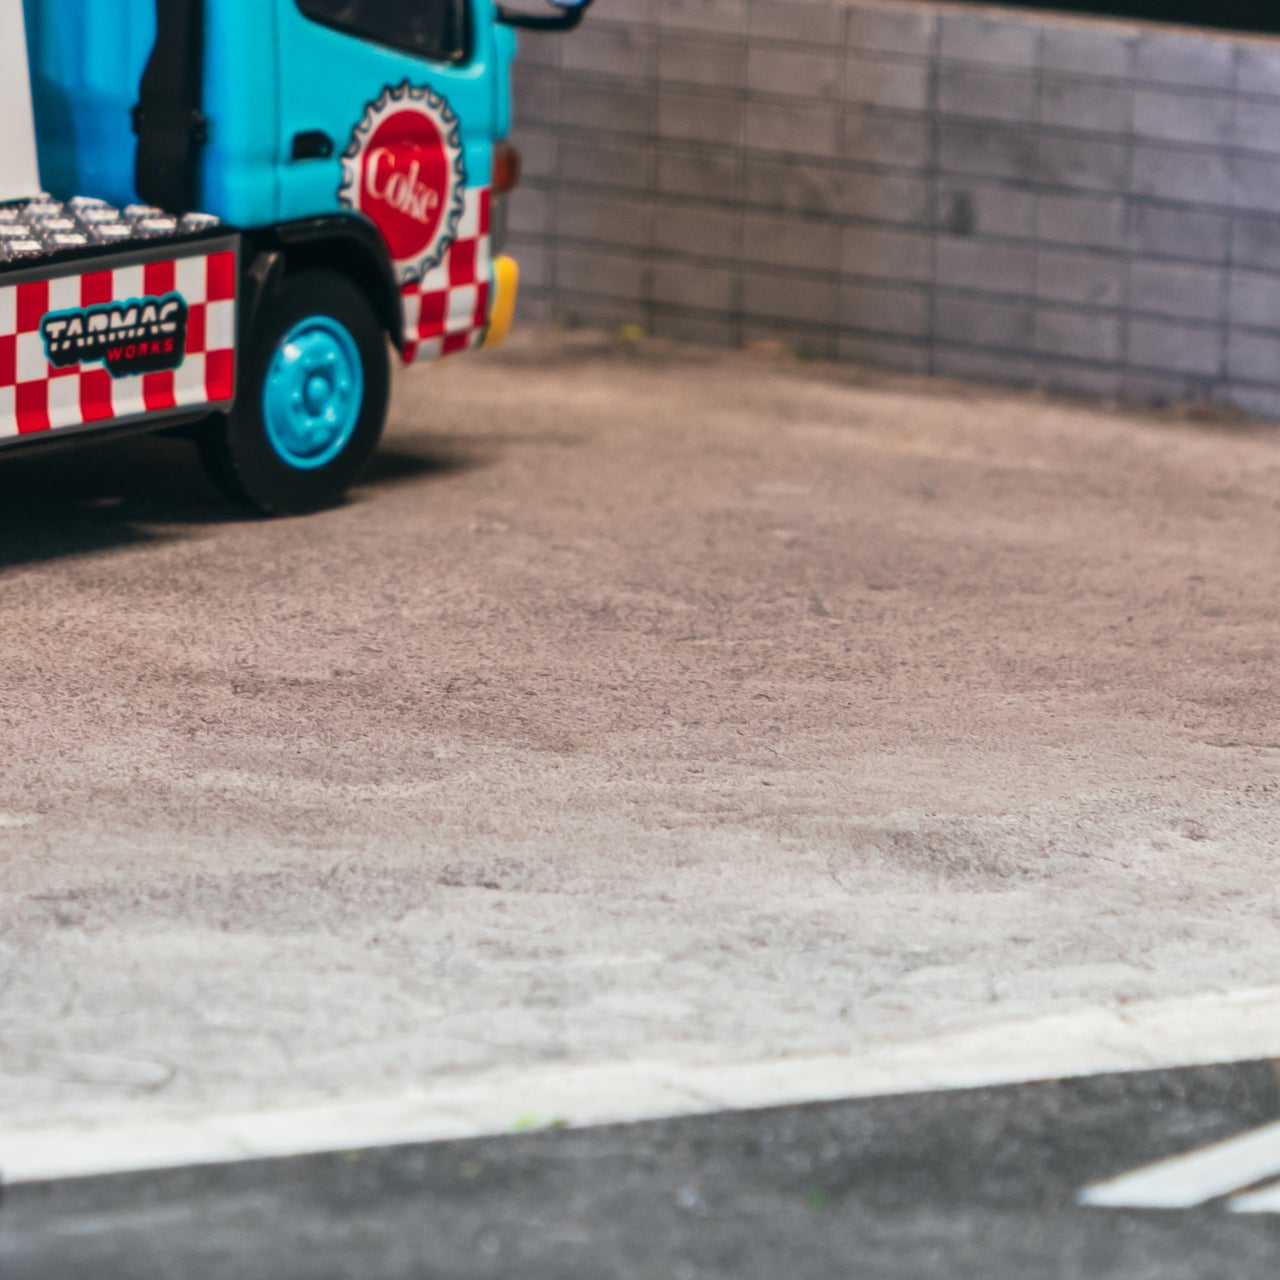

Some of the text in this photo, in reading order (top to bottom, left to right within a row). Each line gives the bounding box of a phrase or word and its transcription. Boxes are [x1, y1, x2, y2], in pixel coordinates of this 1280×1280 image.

[366, 146, 439, 224] Coke
[45, 301, 179, 352] TARMAC
[107, 338, 175, 362] WORKS
